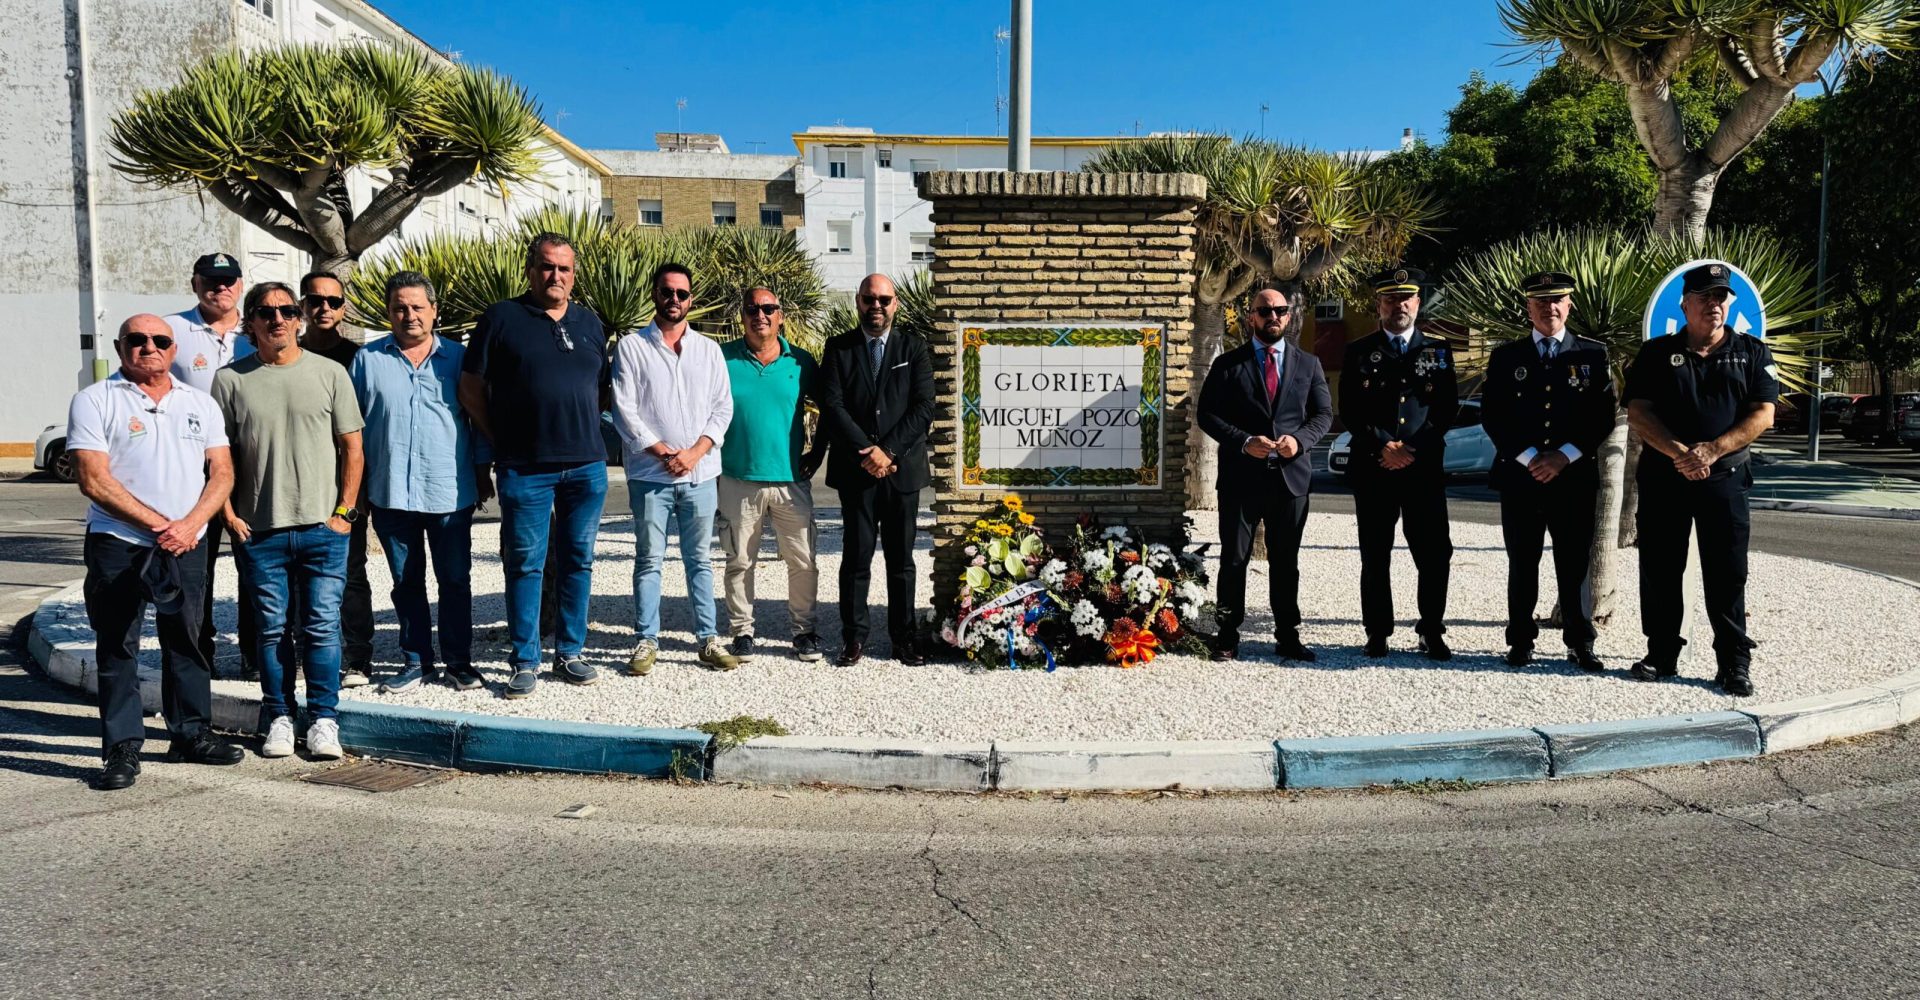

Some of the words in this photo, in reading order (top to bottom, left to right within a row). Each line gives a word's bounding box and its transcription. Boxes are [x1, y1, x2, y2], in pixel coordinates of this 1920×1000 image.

[994, 373, 1128, 392] GLORIETA
[981, 408, 1069, 427] MIGUEL
[1081, 408, 1142, 427] POZO
[1016, 428, 1105, 448] MUÑOZ
